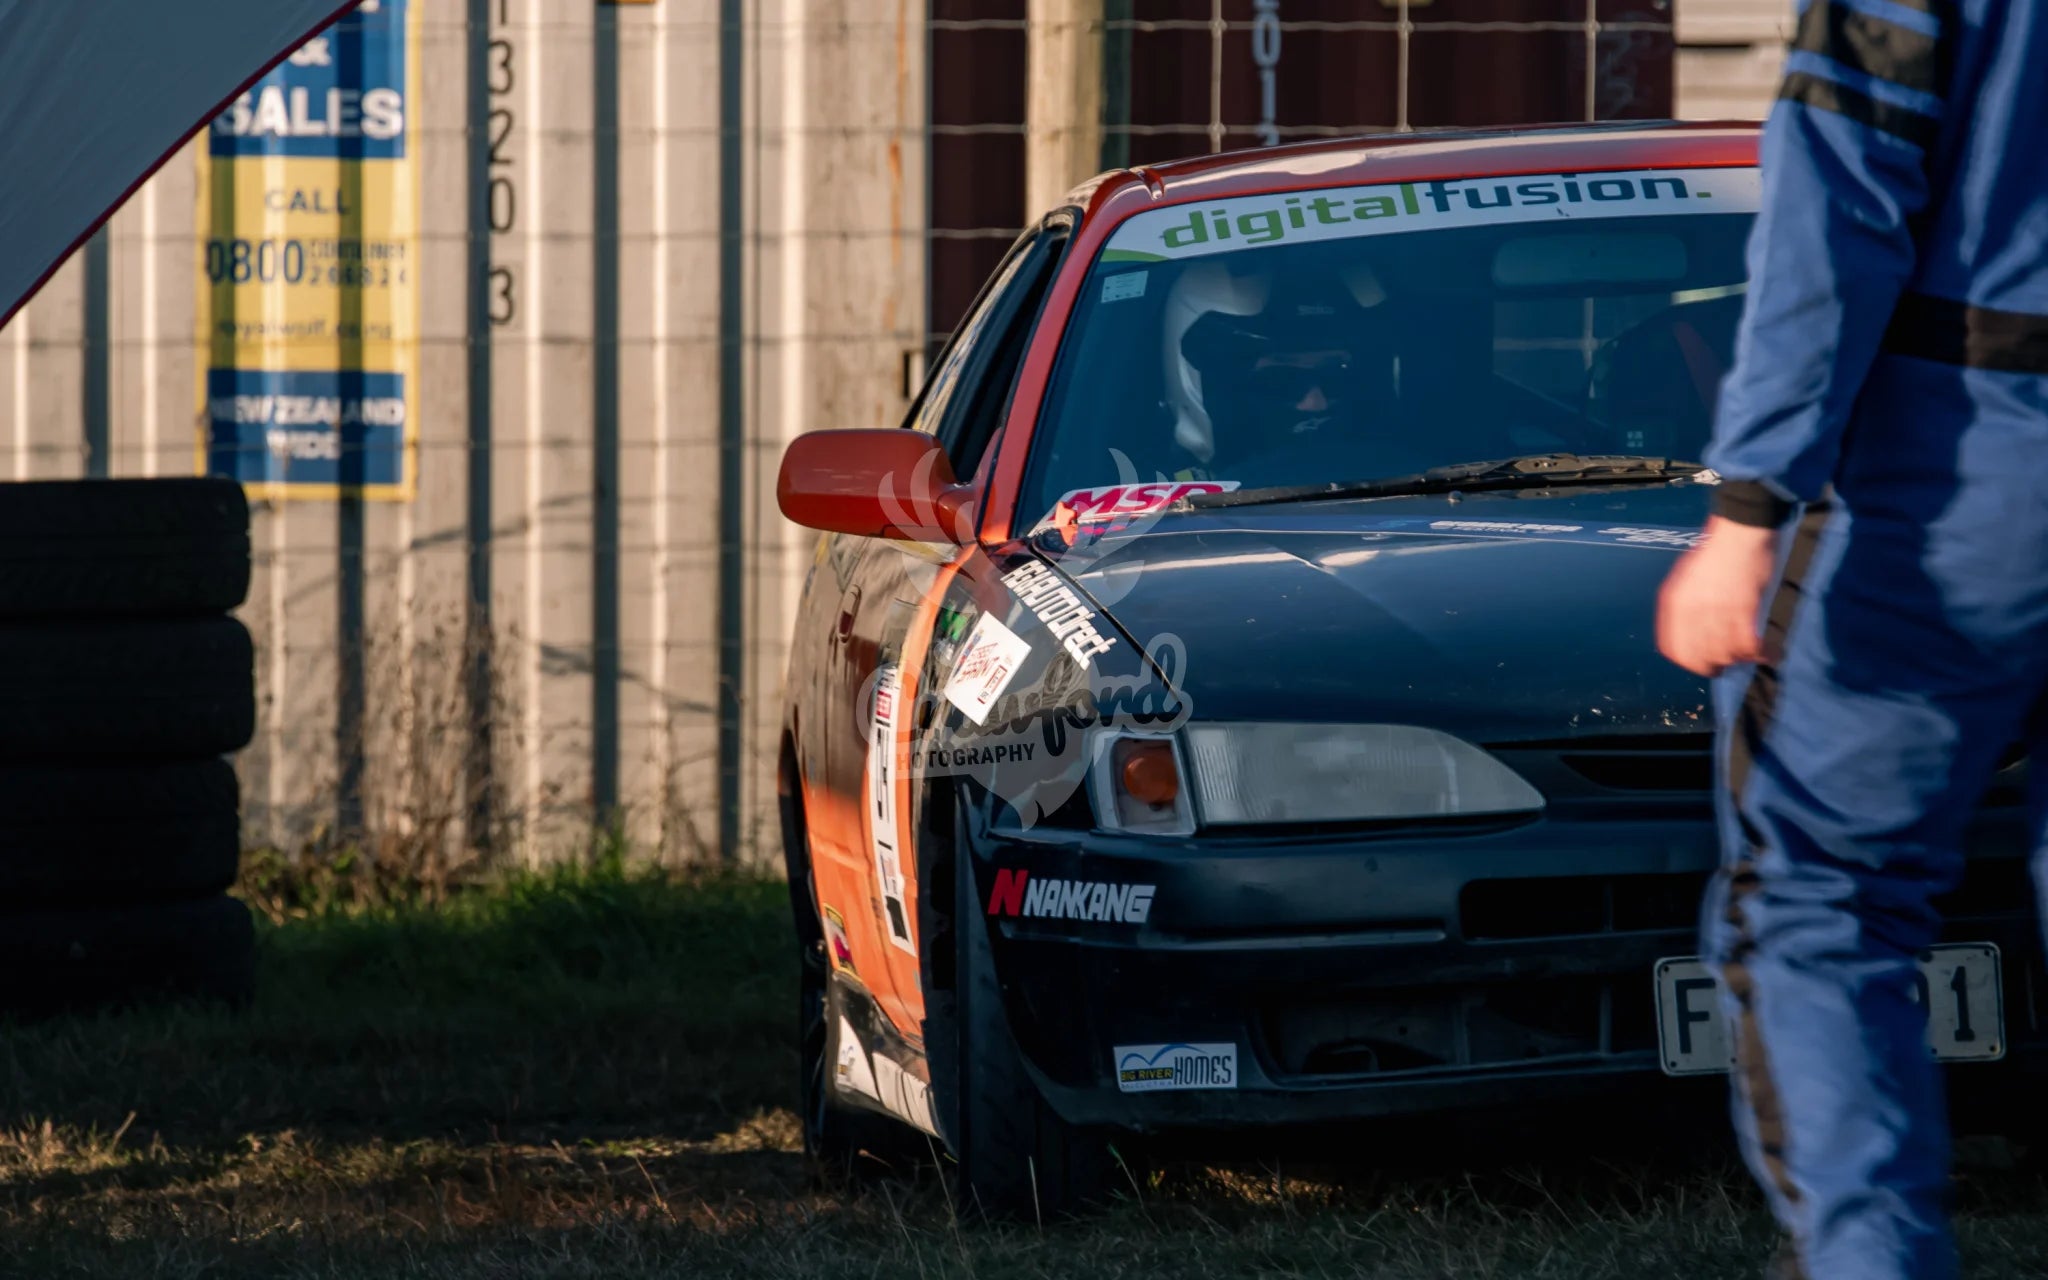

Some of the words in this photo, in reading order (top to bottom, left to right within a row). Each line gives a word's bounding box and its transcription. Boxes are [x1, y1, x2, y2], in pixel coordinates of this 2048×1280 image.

[212, 85, 403, 139] SALES
[265, 188, 353, 215] CALL
[206, 238, 304, 285] 0800
[1022, 878, 1157, 924] NANKANG
[1121, 1069, 1136, 1081] BIG
[1139, 1068, 1173, 1080] RIVER
[1174, 1055, 1232, 1085] HOMES
